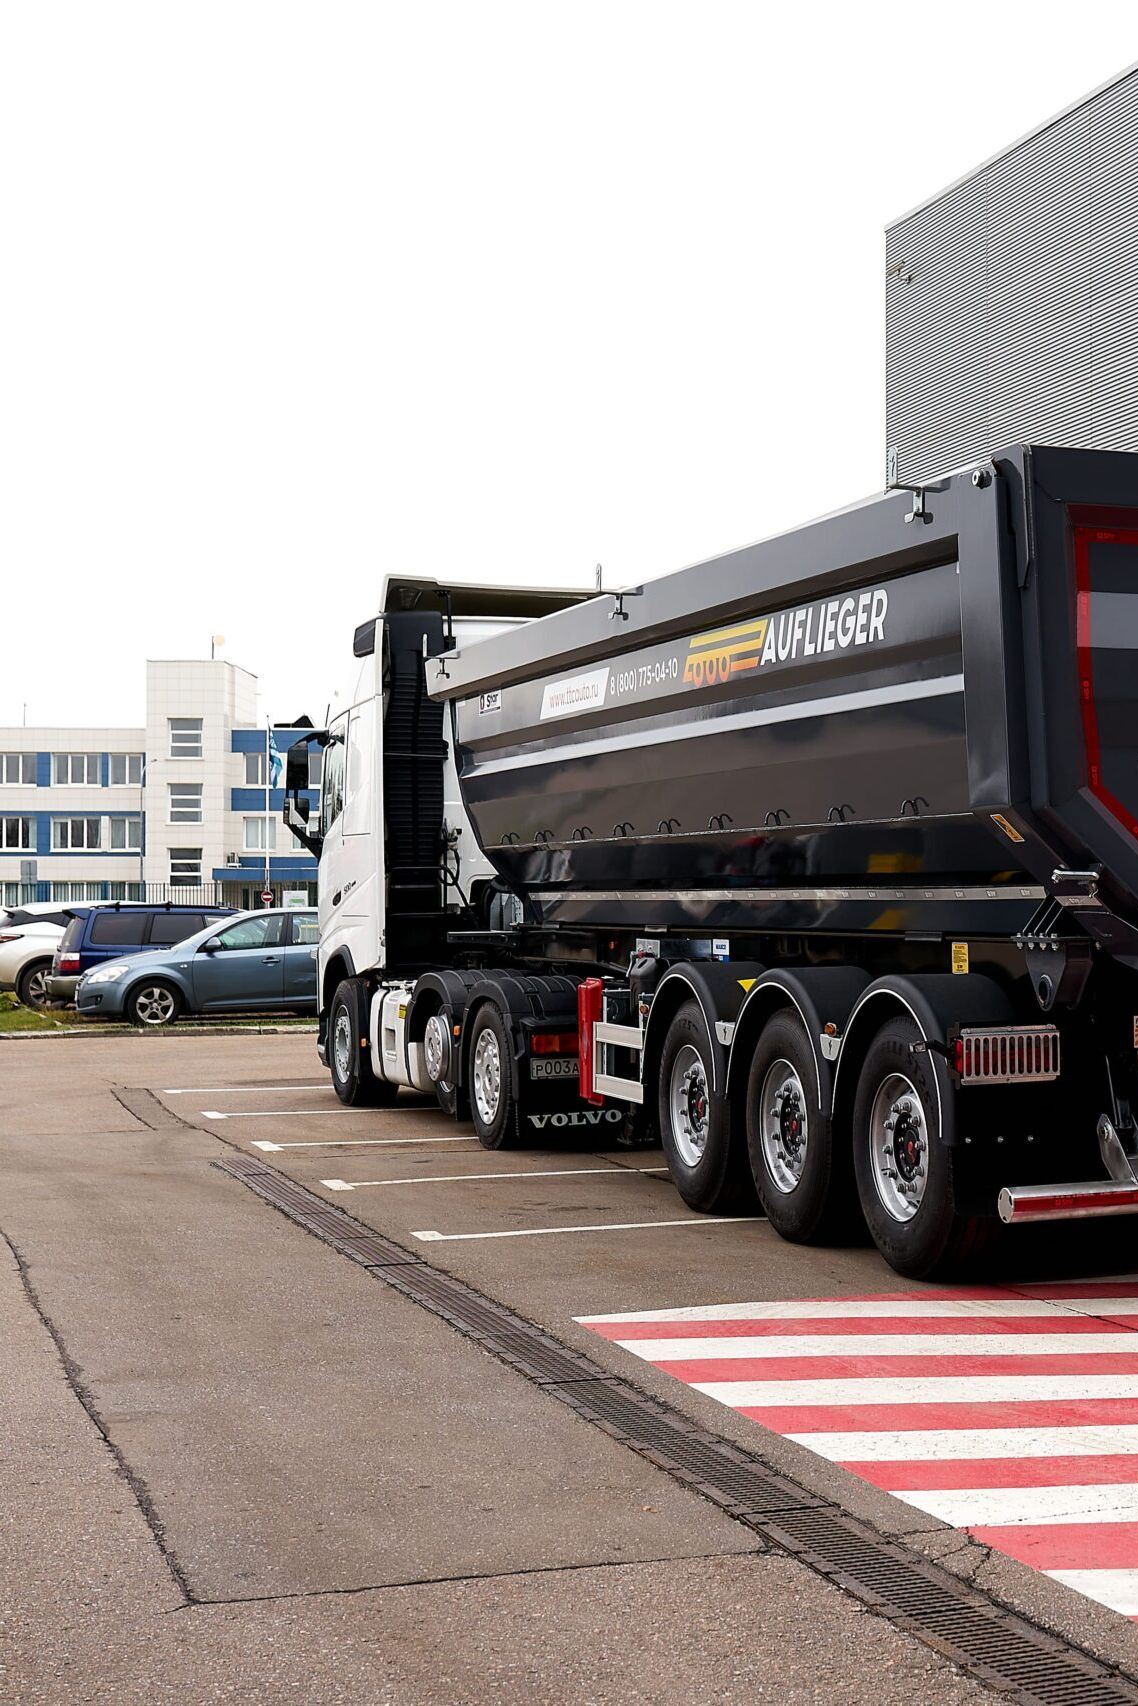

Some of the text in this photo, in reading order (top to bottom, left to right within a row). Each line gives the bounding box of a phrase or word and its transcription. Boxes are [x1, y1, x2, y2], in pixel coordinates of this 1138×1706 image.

[760, 589, 889, 666] AUFLIEGER
[610, 657, 678, 696] 8 (800) 775-04-10
[527, 1109, 623, 1129] VOLVO
